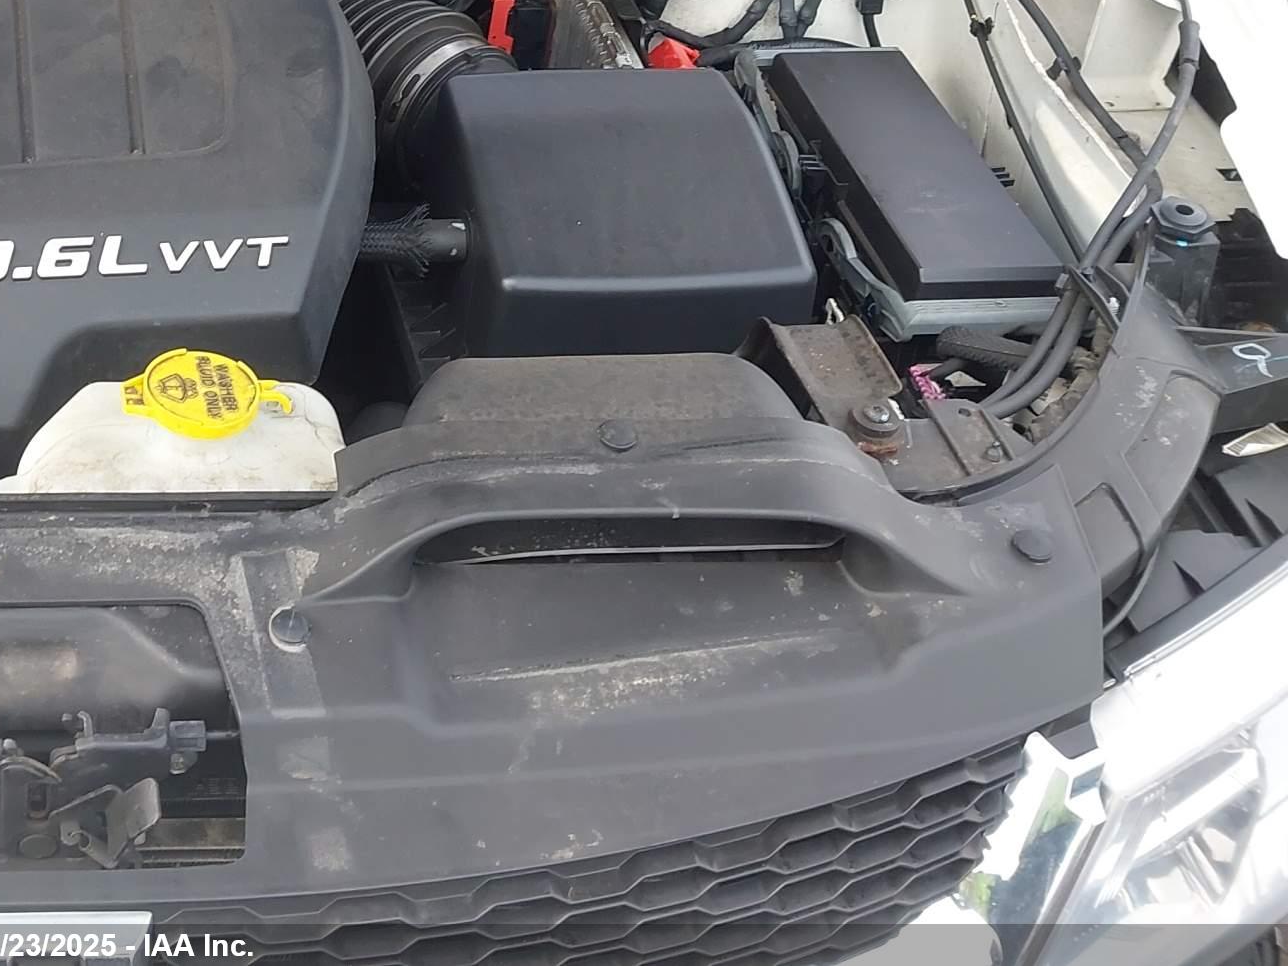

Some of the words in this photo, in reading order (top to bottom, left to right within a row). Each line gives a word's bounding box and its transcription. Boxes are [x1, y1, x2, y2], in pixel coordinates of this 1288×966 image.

[160, 237, 288, 271] VVT
[195, 355, 214, 387] FLUID
[214, 363, 239, 412] WASHER
[204, 390, 223, 420] ONLY
